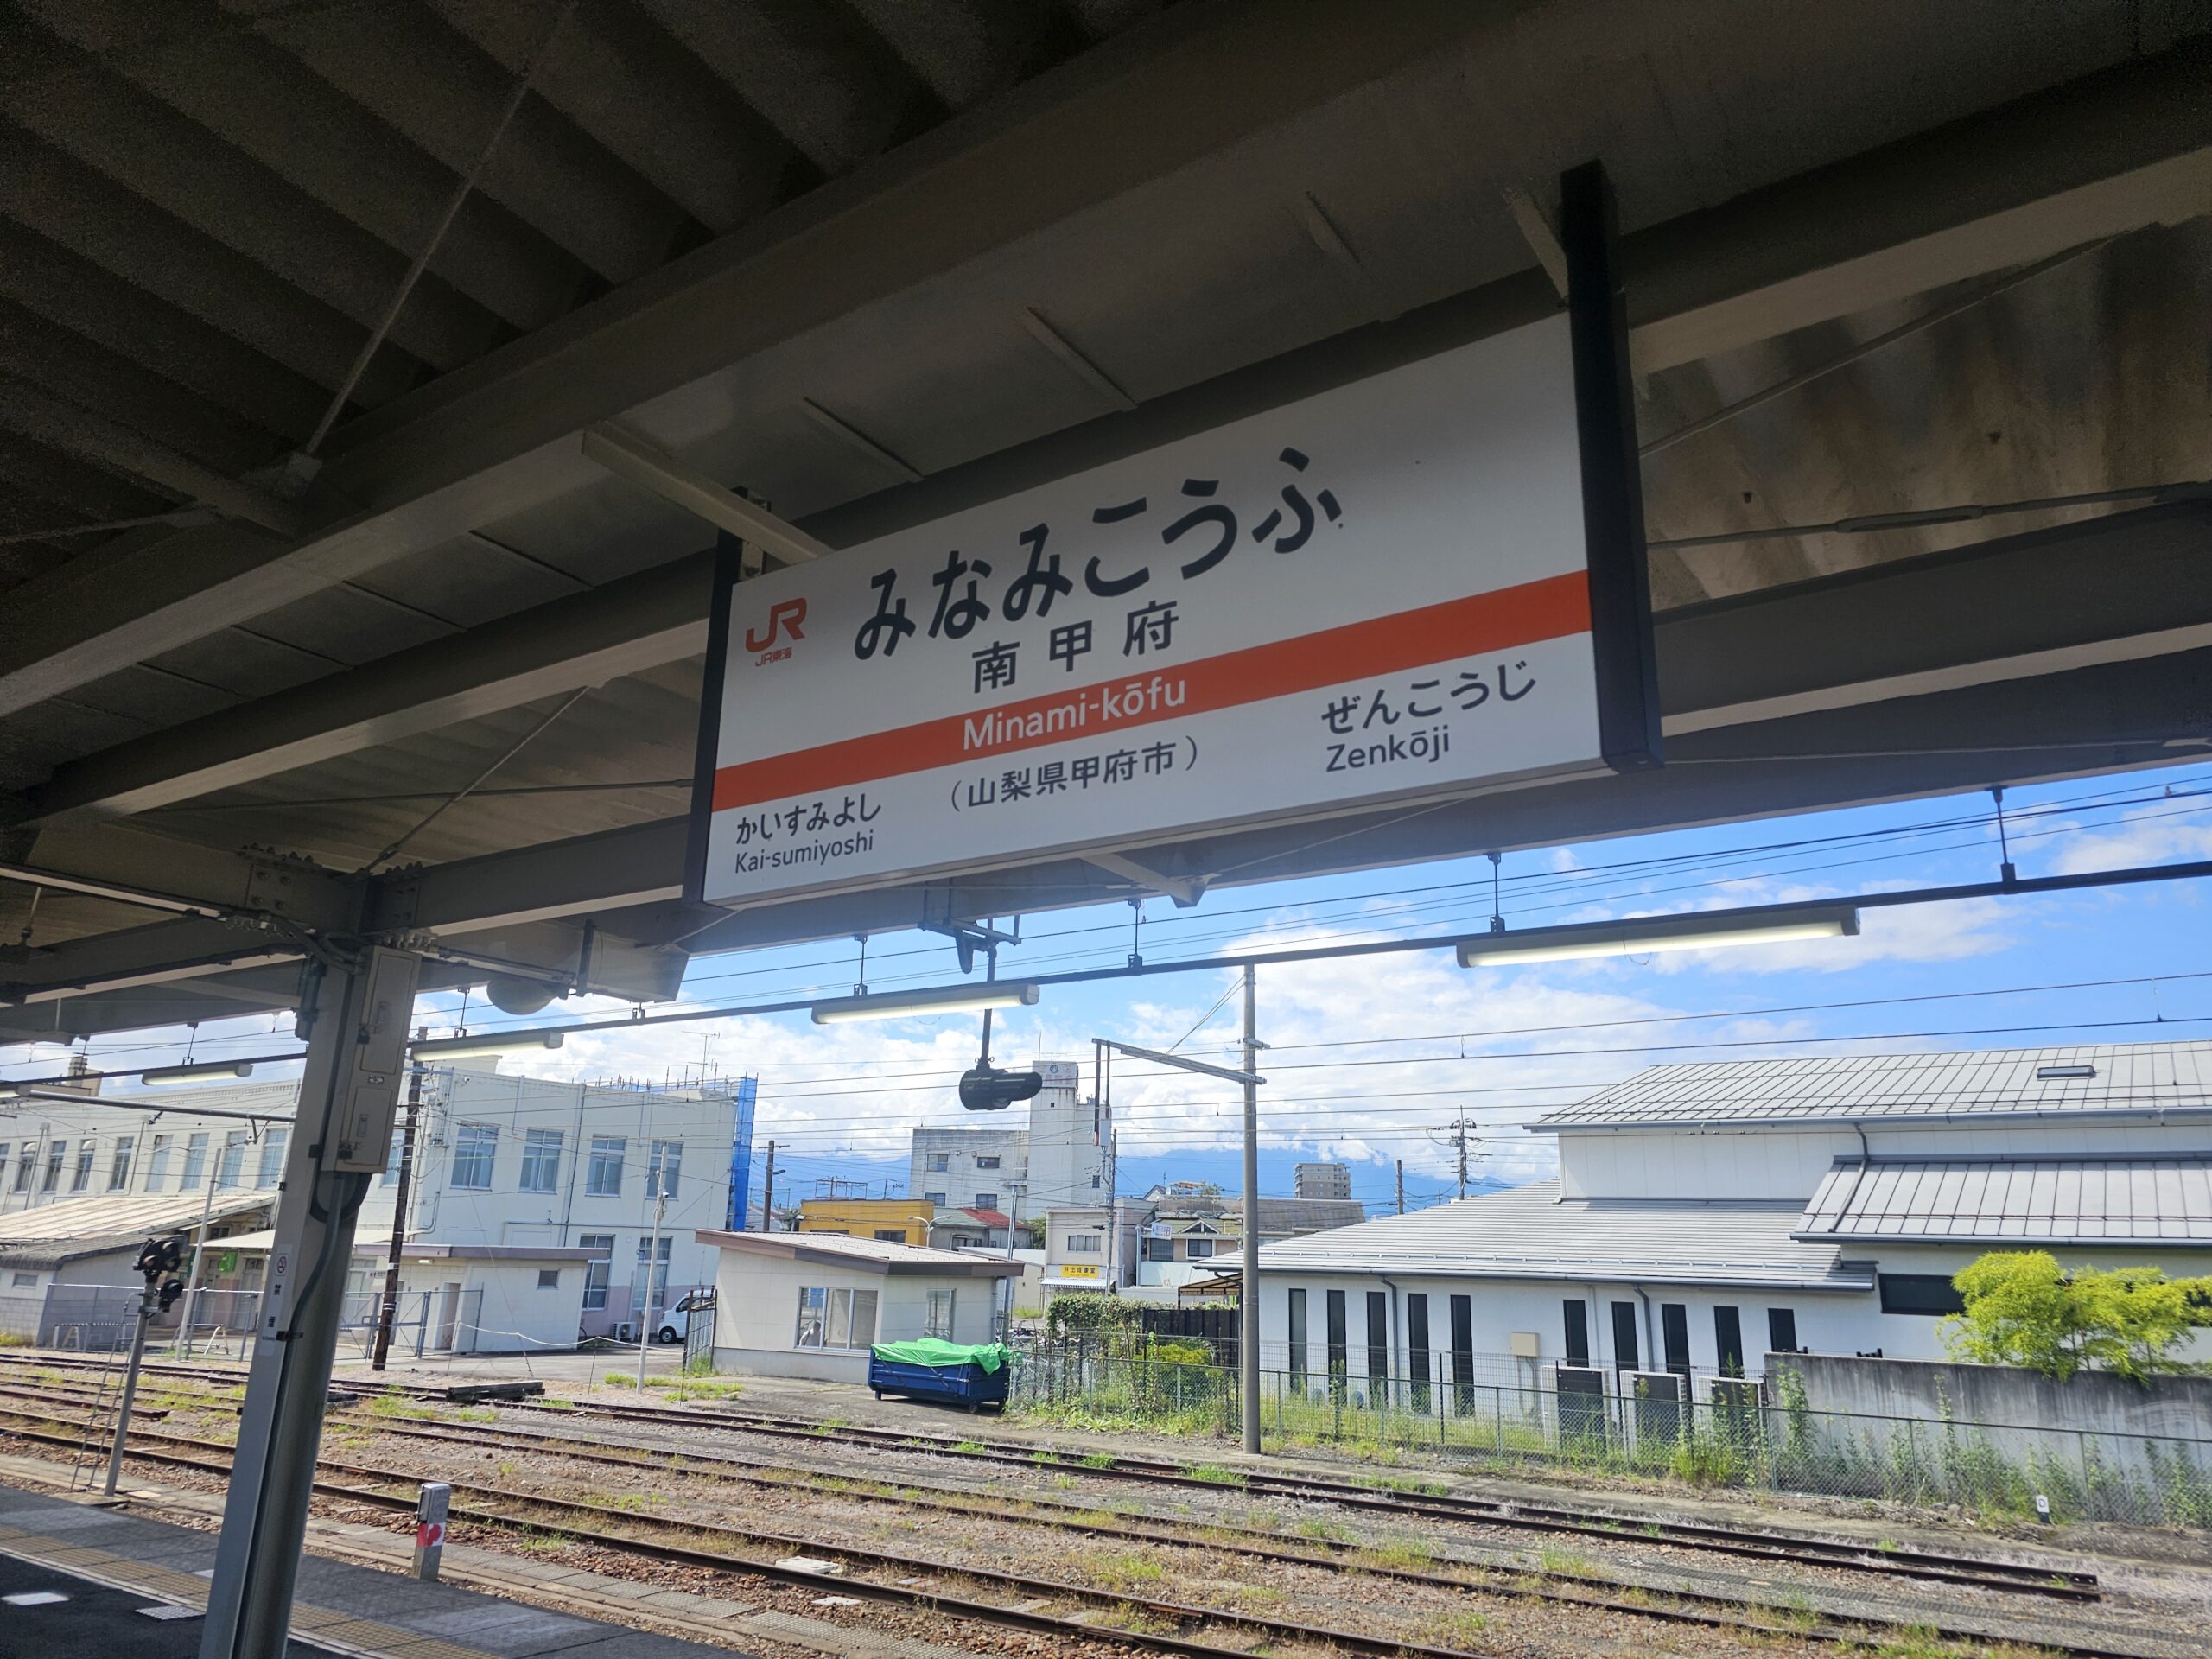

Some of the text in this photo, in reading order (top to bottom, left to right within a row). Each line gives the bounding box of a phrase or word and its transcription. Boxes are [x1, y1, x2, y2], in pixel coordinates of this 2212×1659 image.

[855, 447, 1343, 660] みなみこうふ
[746, 597, 807, 652] JR
[971, 600, 1179, 694] 南甲府
[963, 677, 1185, 750] Minami-kōfu
[1321, 660, 1536, 734] ぜんこうじ
[1326, 724, 1449, 772] Zenkōji
[736, 793, 881, 844] かいすみよし
[735, 830, 874, 874] Kai-sumiyoshi
